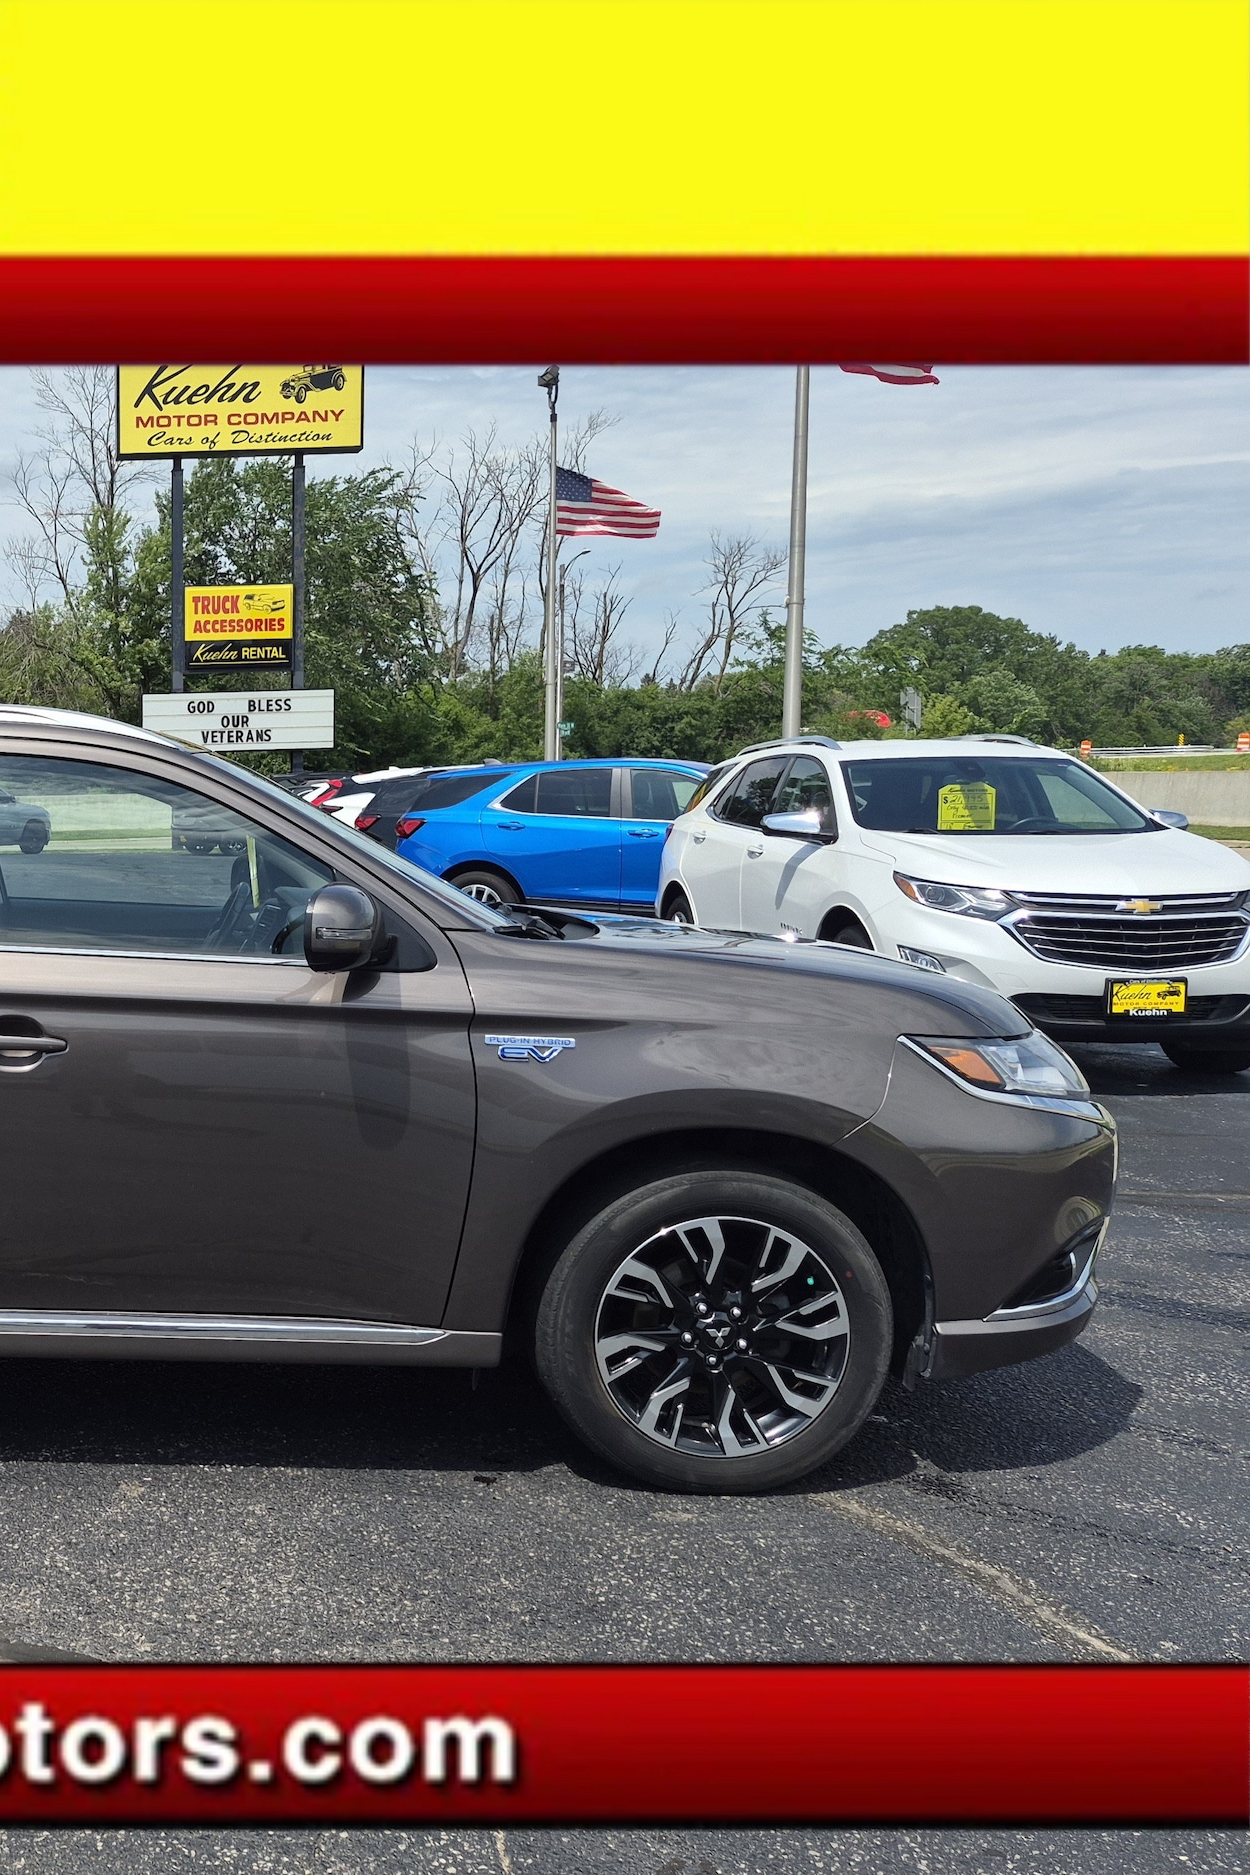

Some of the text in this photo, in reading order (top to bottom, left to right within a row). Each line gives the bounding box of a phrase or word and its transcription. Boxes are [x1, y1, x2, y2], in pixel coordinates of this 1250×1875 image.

[133, 364, 262, 411] Kuehn
[135, 409, 345, 429] MOTOR COMPANY
[147, 430, 333, 449] Cars of Distinction
[192, 595, 240, 615] TRUCK
[193, 618, 285, 634] ACCESSORIES
[192, 643, 286, 663] Kuehn RENTAL
[187, 699, 292, 714] GOD BLESS
[221, 715, 249, 728] OUR
[201, 729, 272, 744] VETERANS
[1112, 985, 1152, 1001] Kuehn
[1130, 1008, 1168, 1016] Kuehn
[489, 1036, 571, 1046] PLUG-IN HYBRID
[497, 1045, 564, 1063] EV
